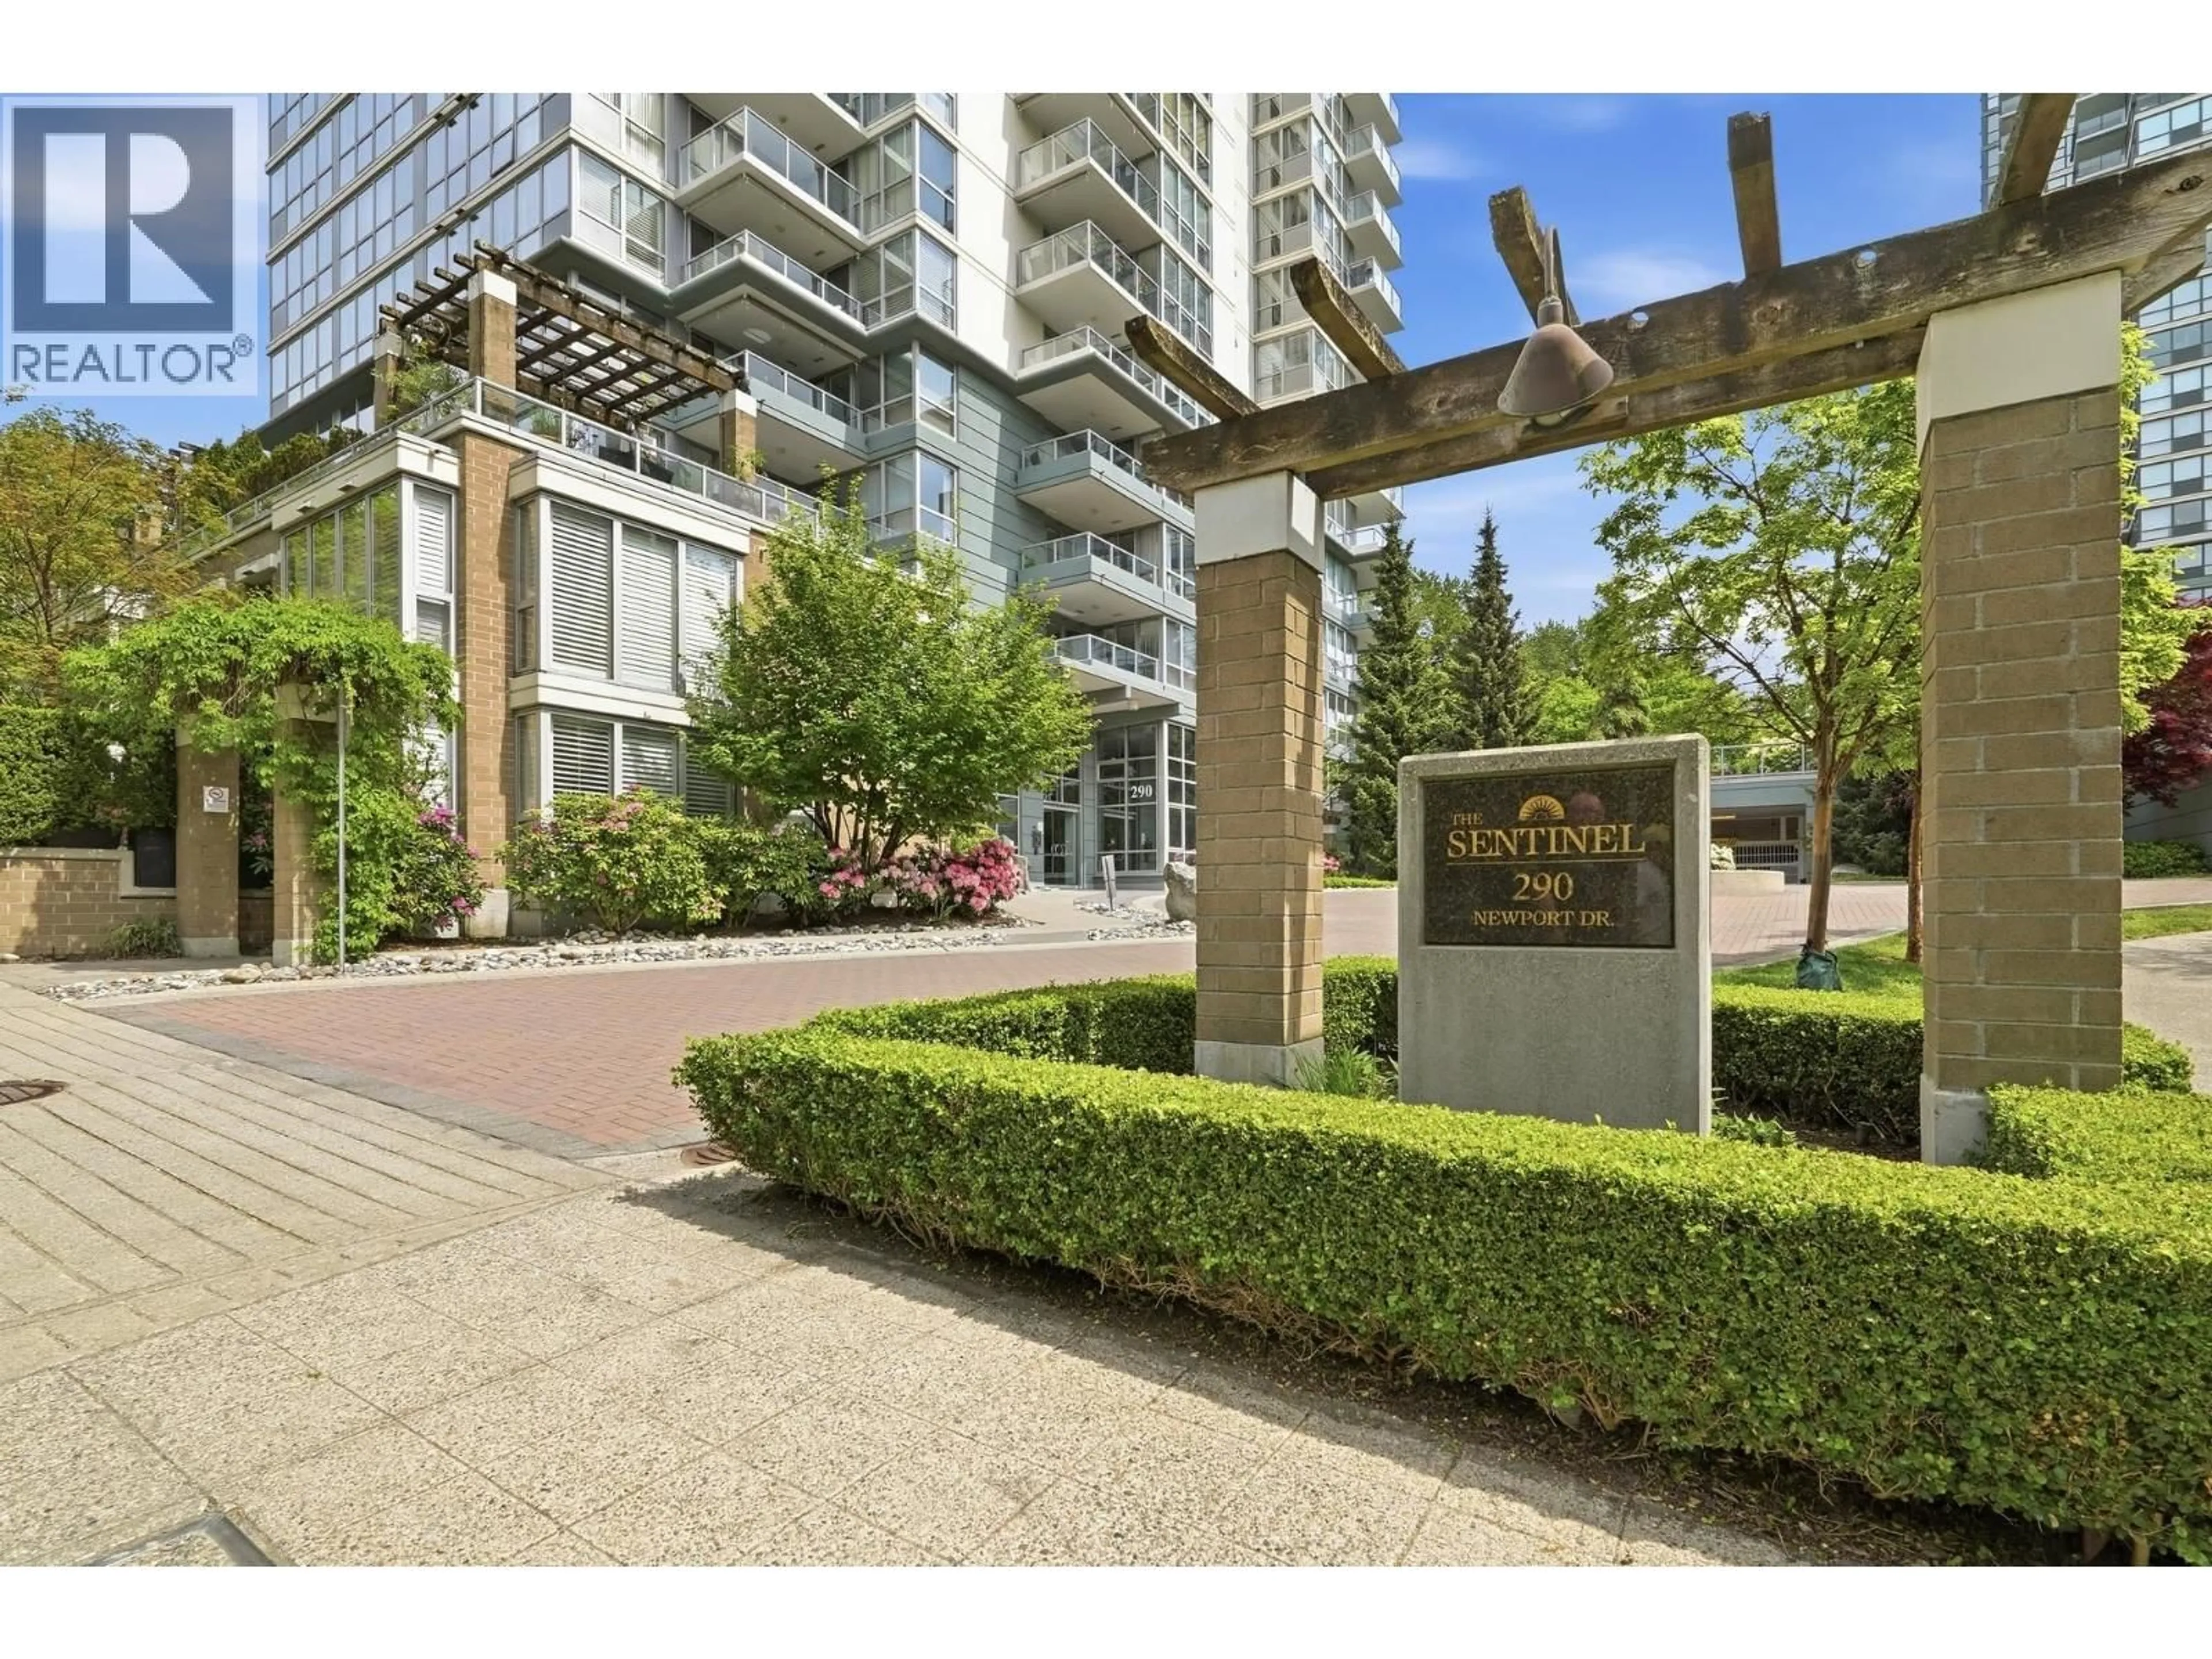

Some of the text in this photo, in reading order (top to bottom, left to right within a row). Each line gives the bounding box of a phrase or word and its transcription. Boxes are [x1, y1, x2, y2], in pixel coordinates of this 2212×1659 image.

[1130, 785, 1153, 798] 290
[1452, 812, 1483, 825] THE
[1448, 824, 1645, 858] SENTINEL
[1512, 872, 1574, 901] 290
[1473, 910, 1614, 927] NEWPORT DR.
